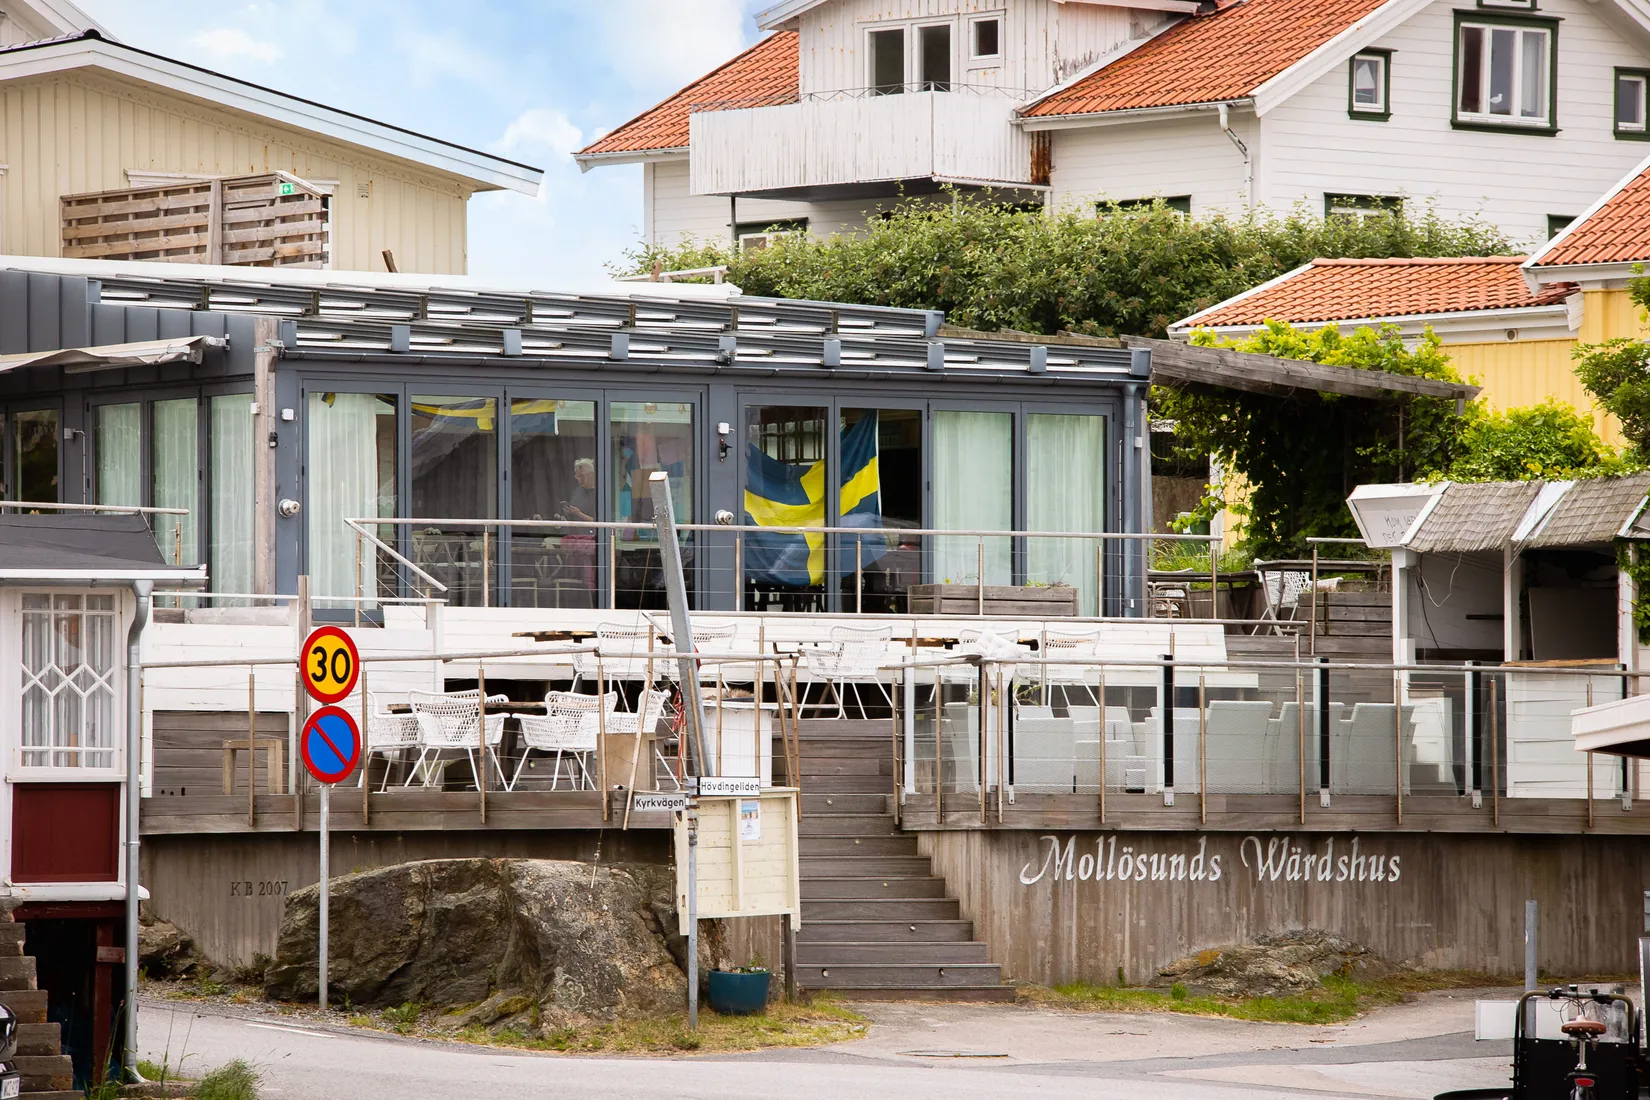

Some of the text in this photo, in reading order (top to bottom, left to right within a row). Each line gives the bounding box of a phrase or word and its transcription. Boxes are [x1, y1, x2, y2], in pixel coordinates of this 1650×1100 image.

[311, 646, 350, 684] 30
[701, 781, 760, 793] Hövdingeliden
[635, 797, 684, 809] Kyrkvägen
[1019, 834, 1401, 885] Mollösunds Wärdshus
[258, 880, 288, 896] 2007
